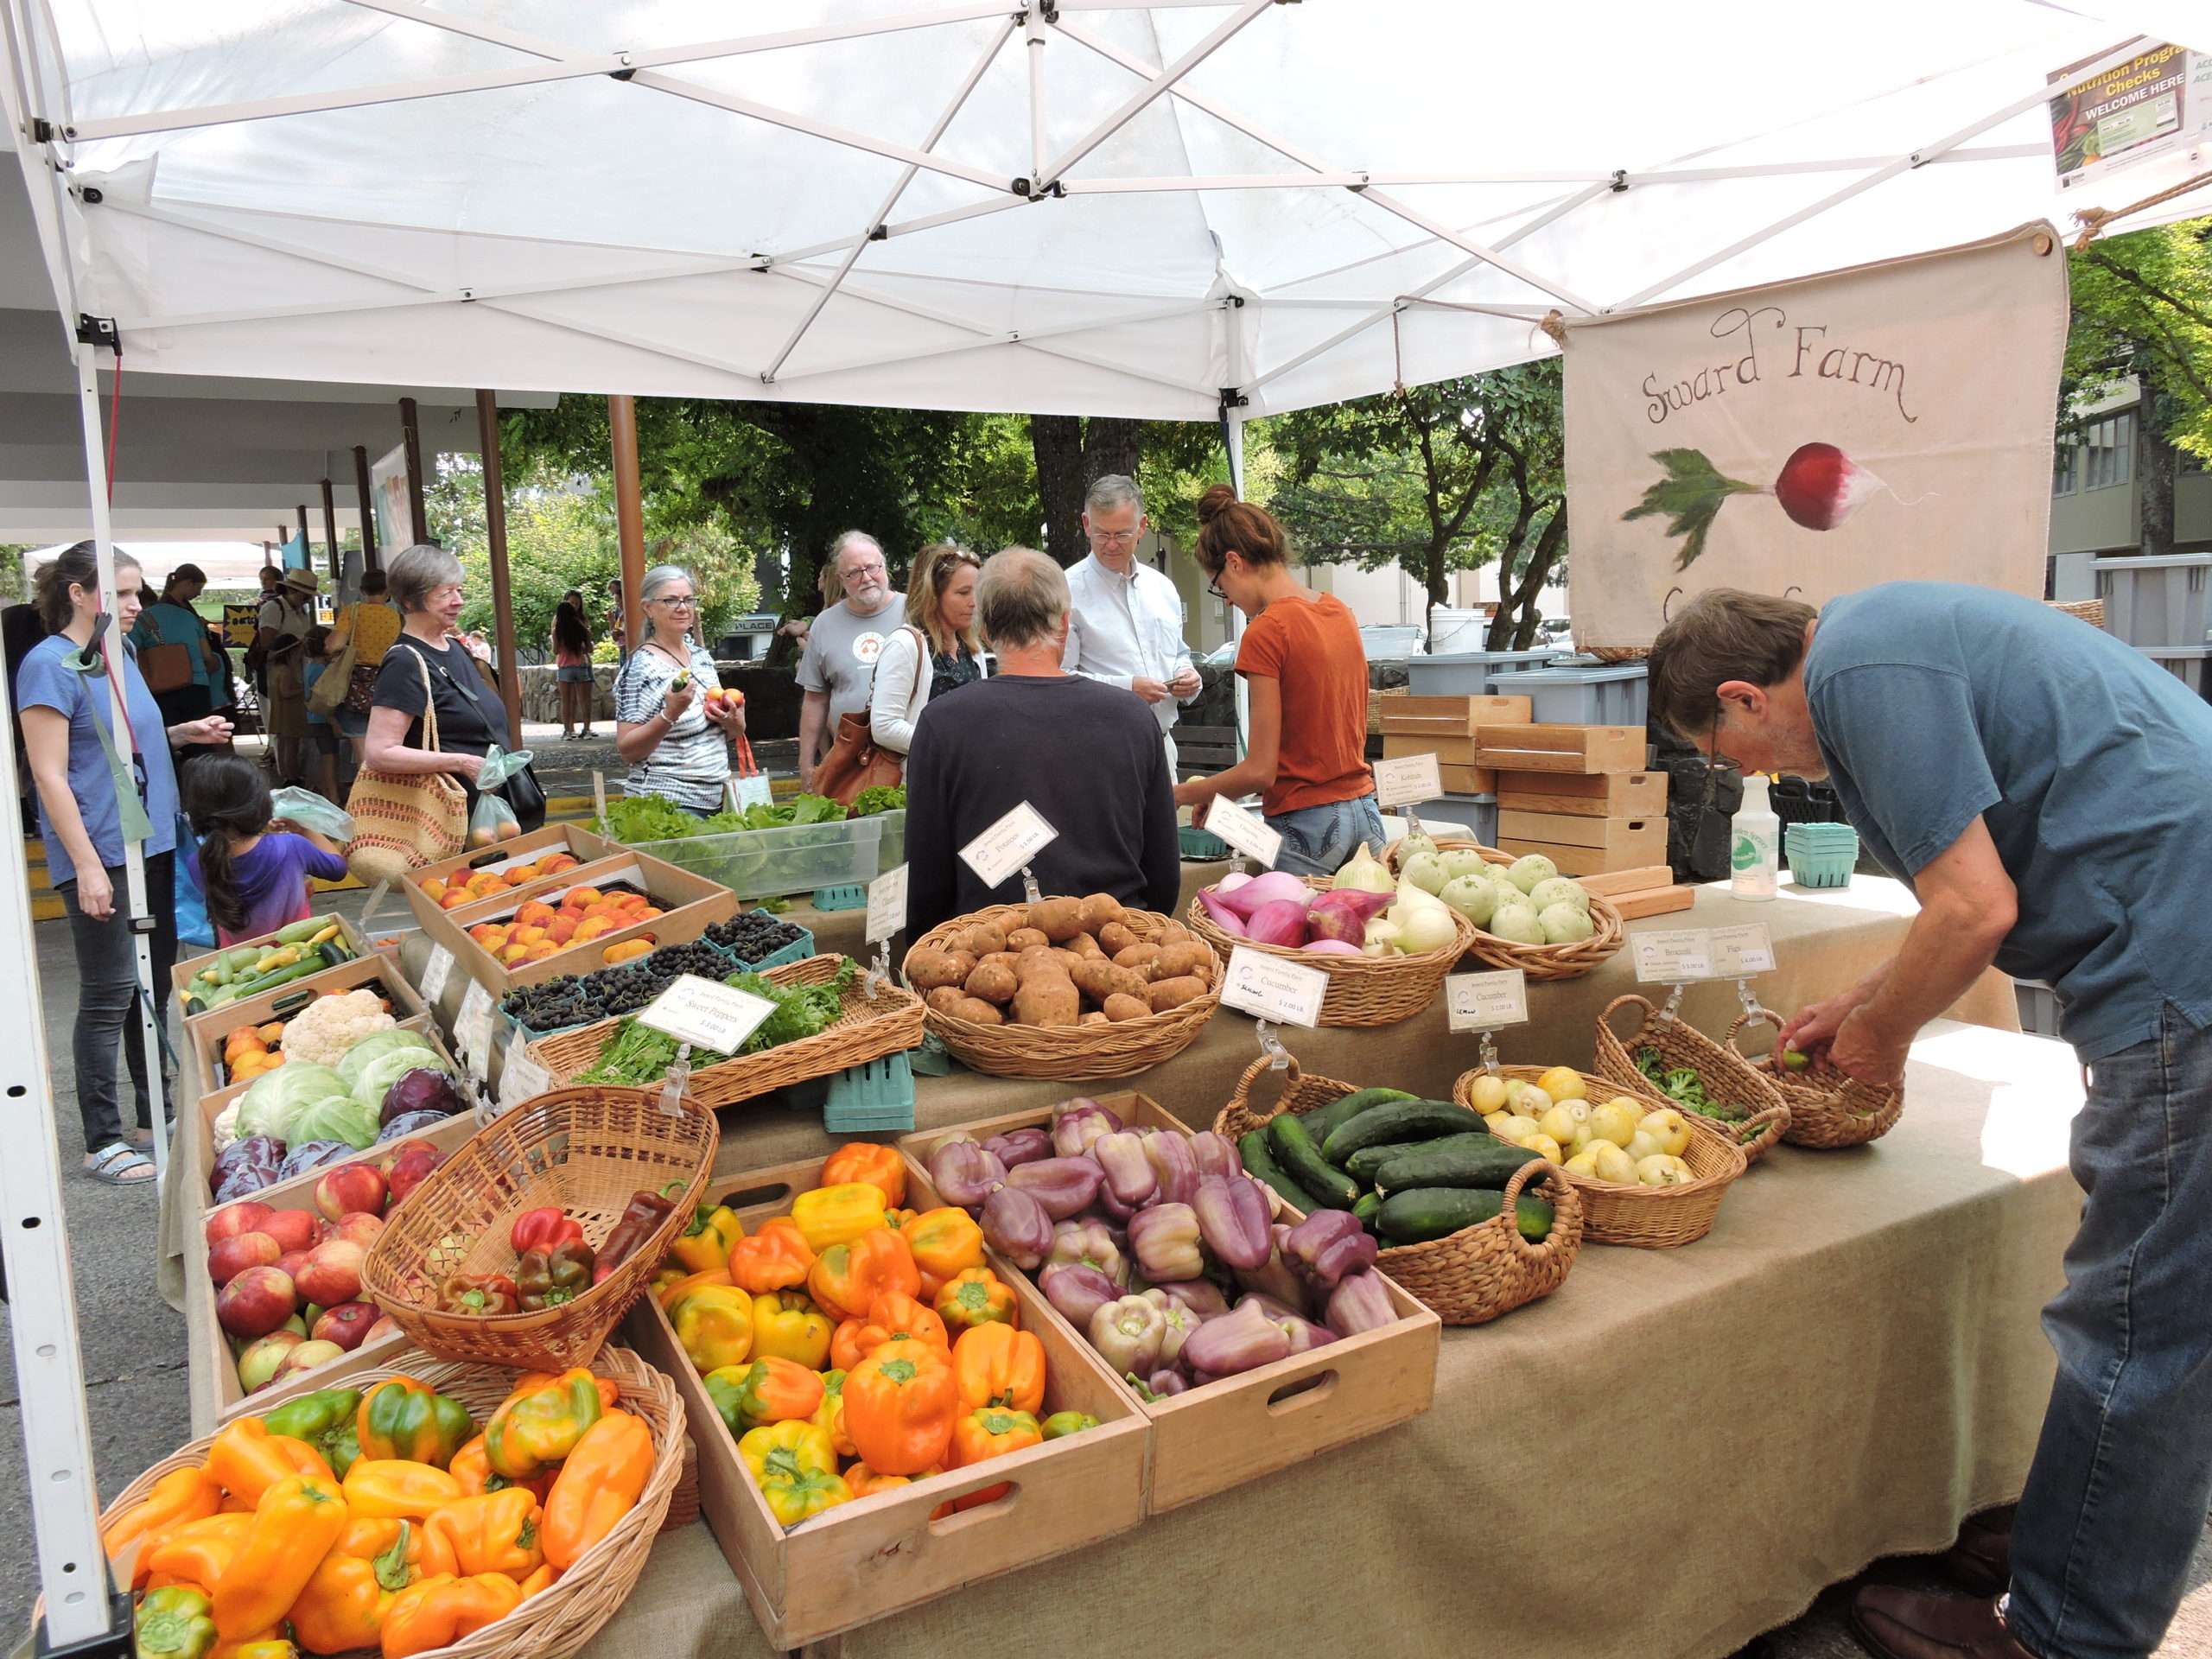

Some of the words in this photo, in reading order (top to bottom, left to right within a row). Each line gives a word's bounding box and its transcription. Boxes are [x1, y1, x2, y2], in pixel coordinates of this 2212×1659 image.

[2133, 46, 2185, 70] Progra
[2085, 88, 2148, 120] WELCOME
[2151, 73, 2185, 95] HERE
[2106, 67, 2161, 97] Checks
[1642, 307, 1786, 423] Sward
[1788, 326, 1918, 423] Farm
[1260, 976, 1298, 995] Cucumber
